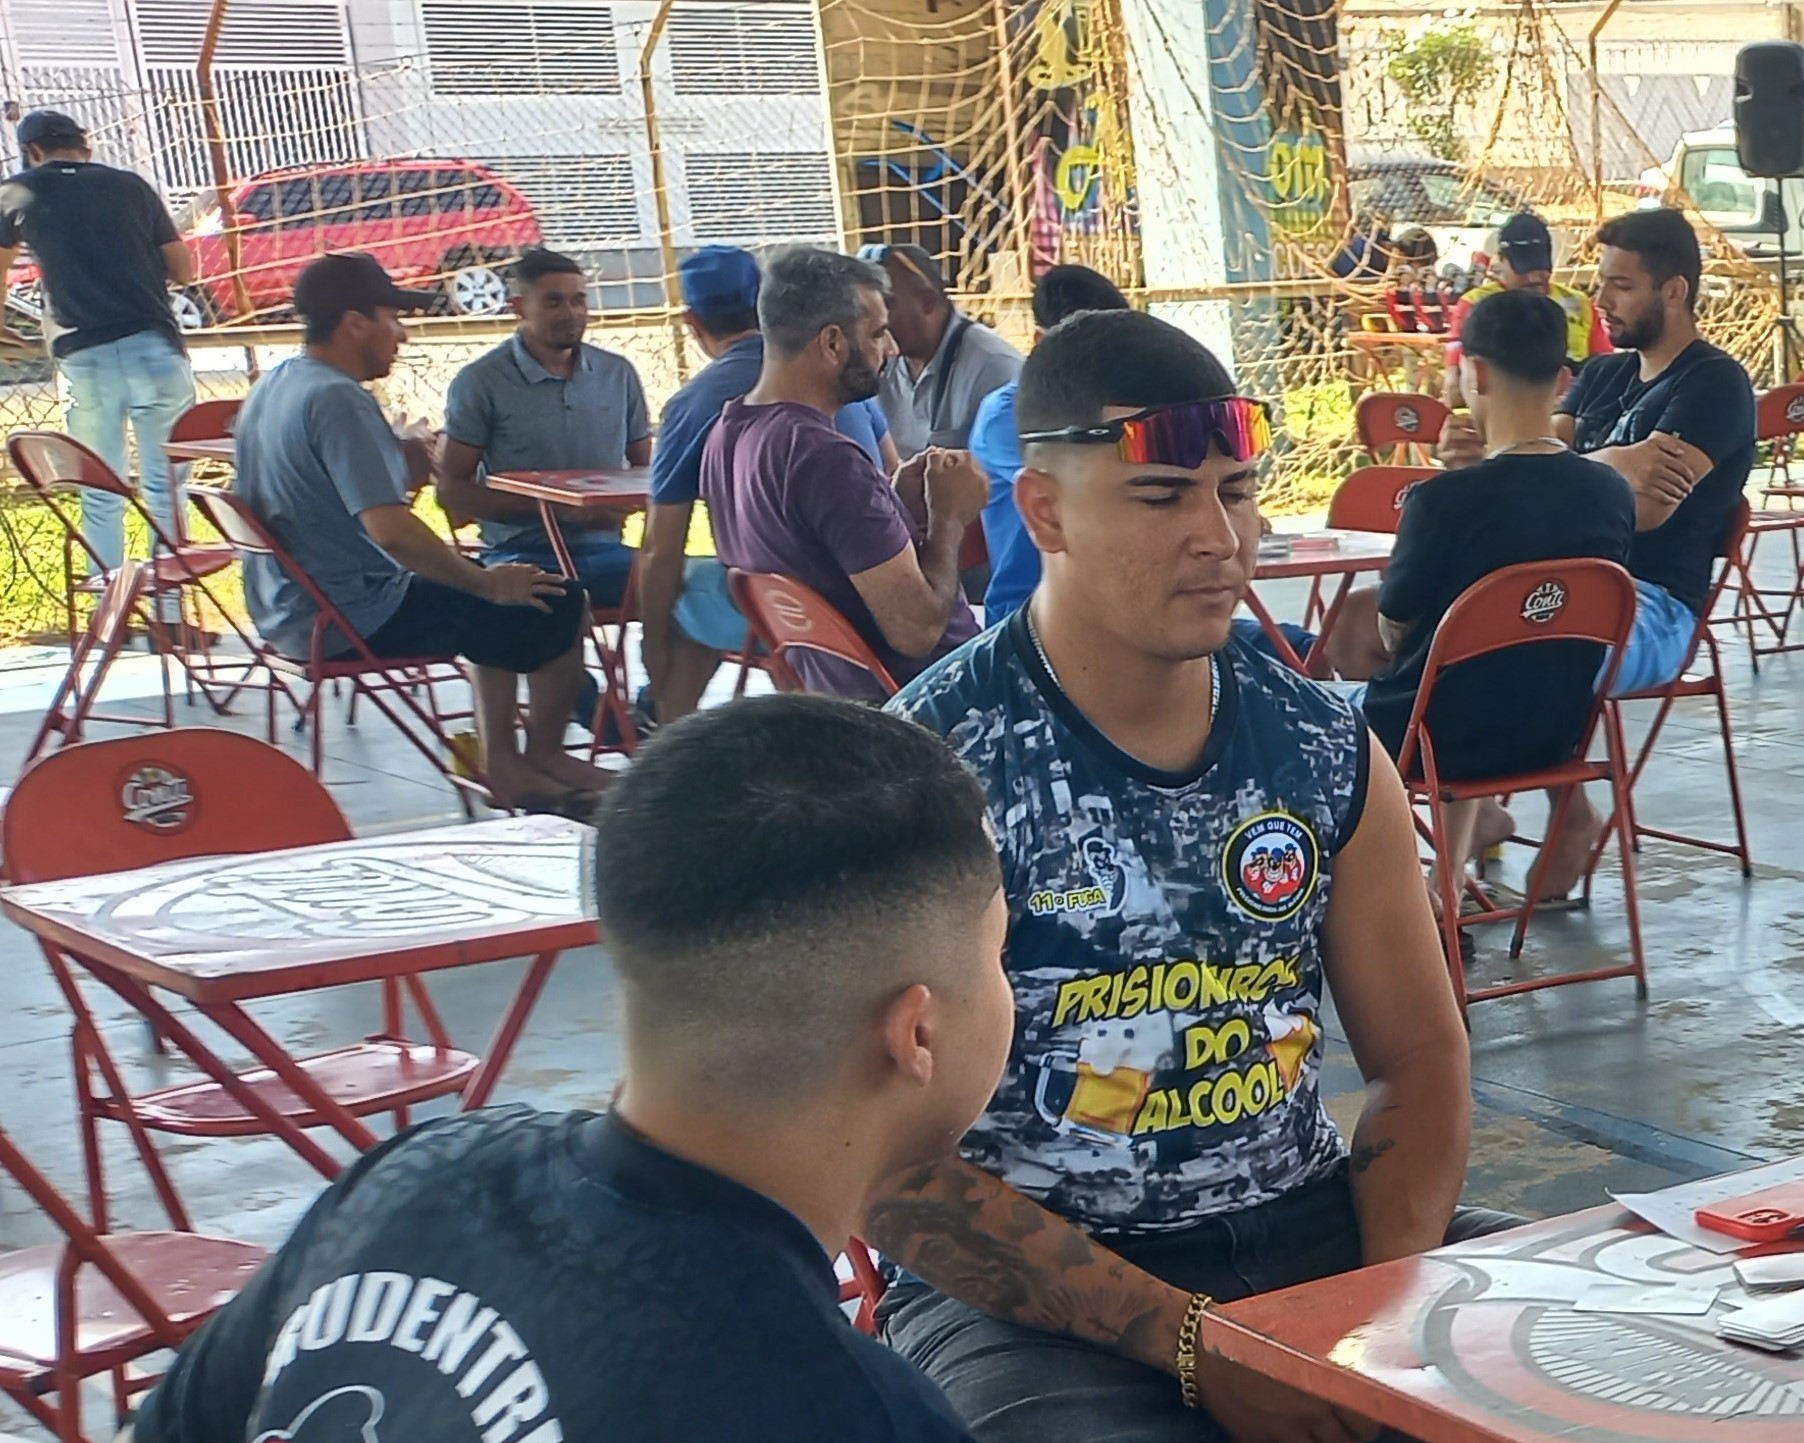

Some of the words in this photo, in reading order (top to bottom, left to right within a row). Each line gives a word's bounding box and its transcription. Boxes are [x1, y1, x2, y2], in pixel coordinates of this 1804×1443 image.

[1521, 588, 1566, 616] Conti
[1066, 886, 1108, 910] FUGA
[1184, 1017, 1251, 1072] DO
[1130, 1058, 1287, 1138] ALCOOL
